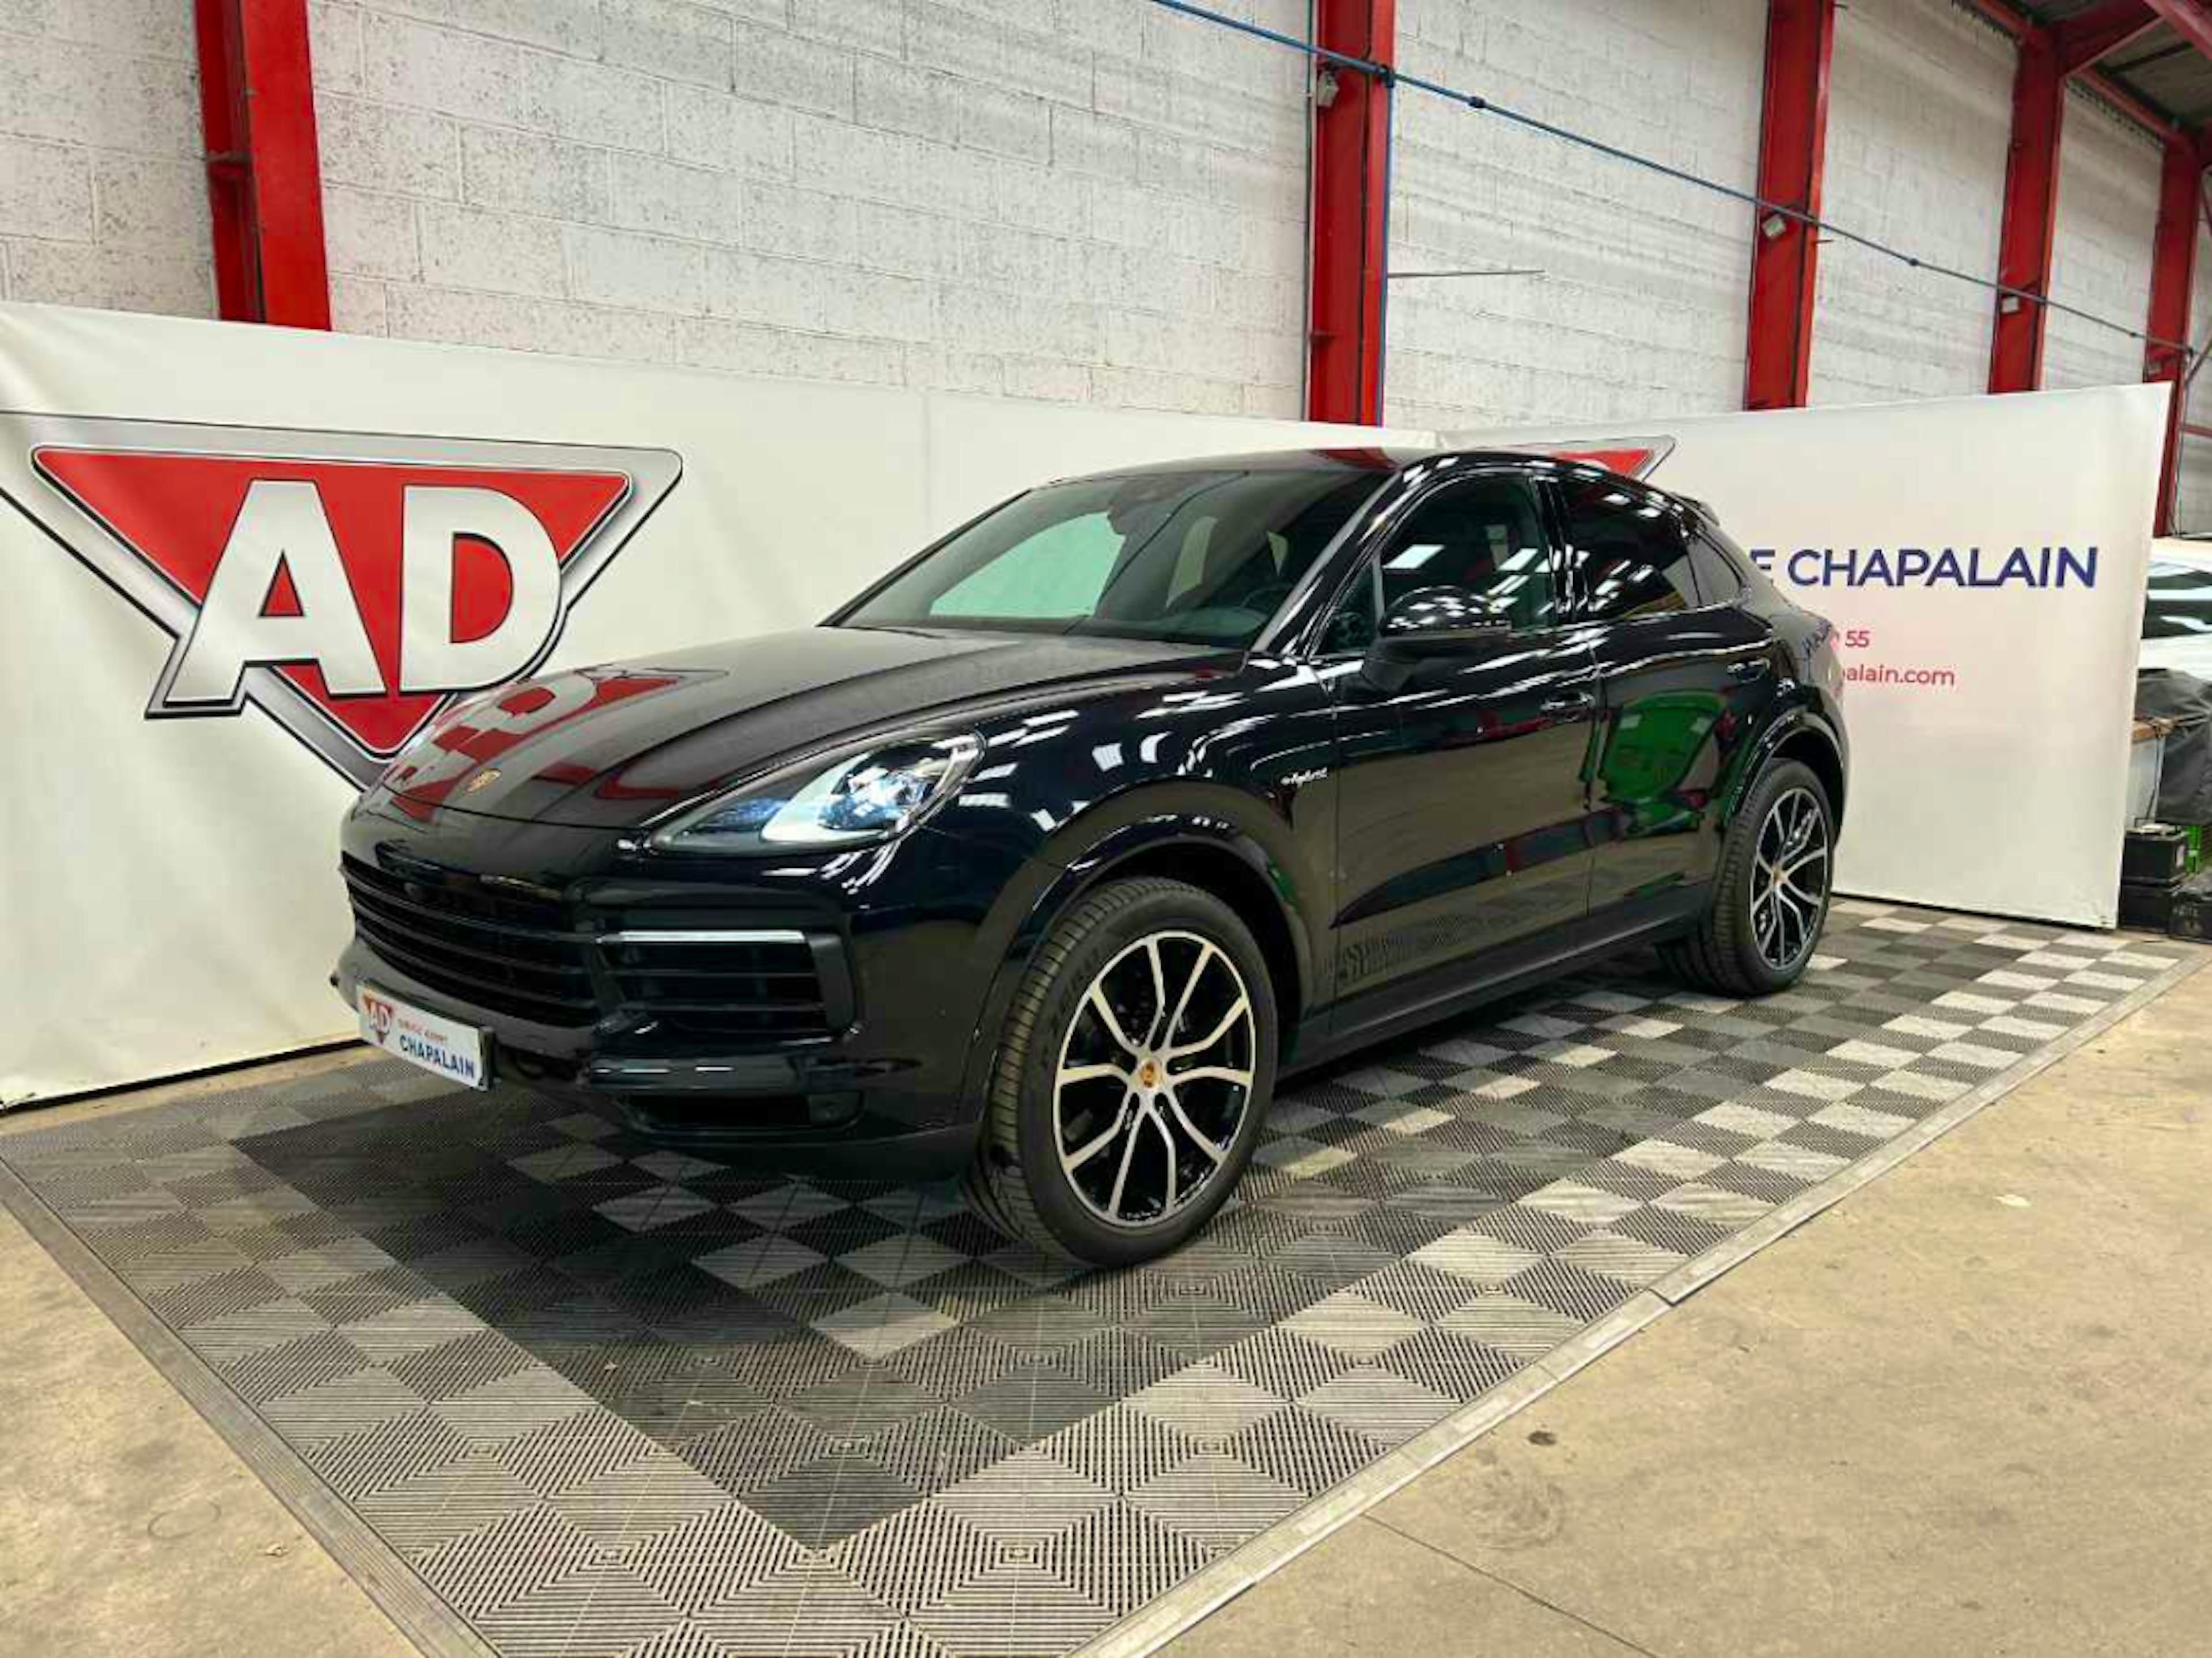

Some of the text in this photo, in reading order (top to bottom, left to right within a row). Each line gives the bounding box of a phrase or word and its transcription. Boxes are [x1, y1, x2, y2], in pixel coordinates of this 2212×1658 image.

[1787, 547, 2098, 588] CHAPALAIN
[164, 478, 562, 705] AD
[1844, 630, 1870, 648] 55
[1843, 664, 1955, 686] alain.com
[400, 1035, 474, 1078] CHAPALAIN
